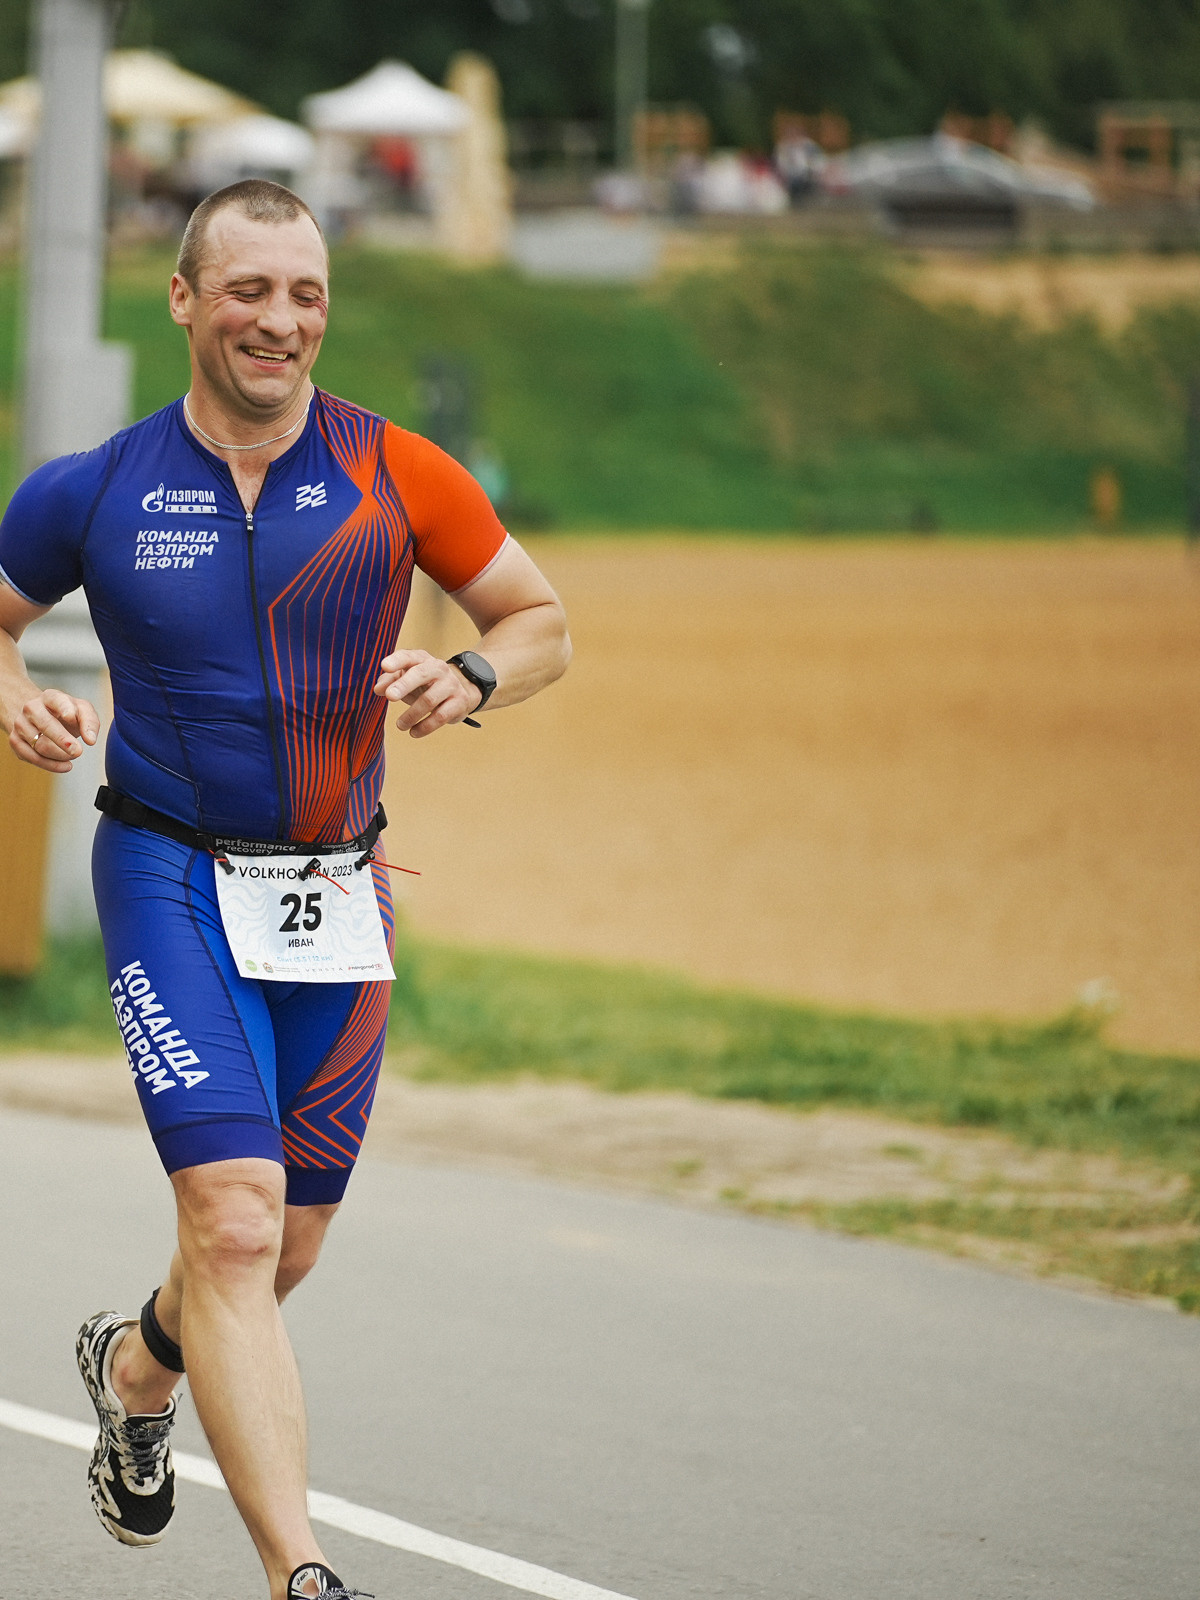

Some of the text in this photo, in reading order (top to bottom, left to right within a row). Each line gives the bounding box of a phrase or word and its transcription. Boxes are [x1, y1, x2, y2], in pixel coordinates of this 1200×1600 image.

[166, 490, 216, 503] ГАЗПРОМ
[136, 530, 219, 543] КОМАНДА
[135, 544, 214, 556] ГАЗПРОМ
[135, 556, 195, 570] НЕФТИ
[215, 838, 297, 852] performance
[227, 845, 273, 855] recovery
[331, 864, 353, 878] 2023
[279, 892, 322, 932] 25
[288, 938, 314, 948] ИВАН
[120, 960, 211, 1089] КОМАНДА
[110, 978, 177, 1095] ГАЗПРОМ
